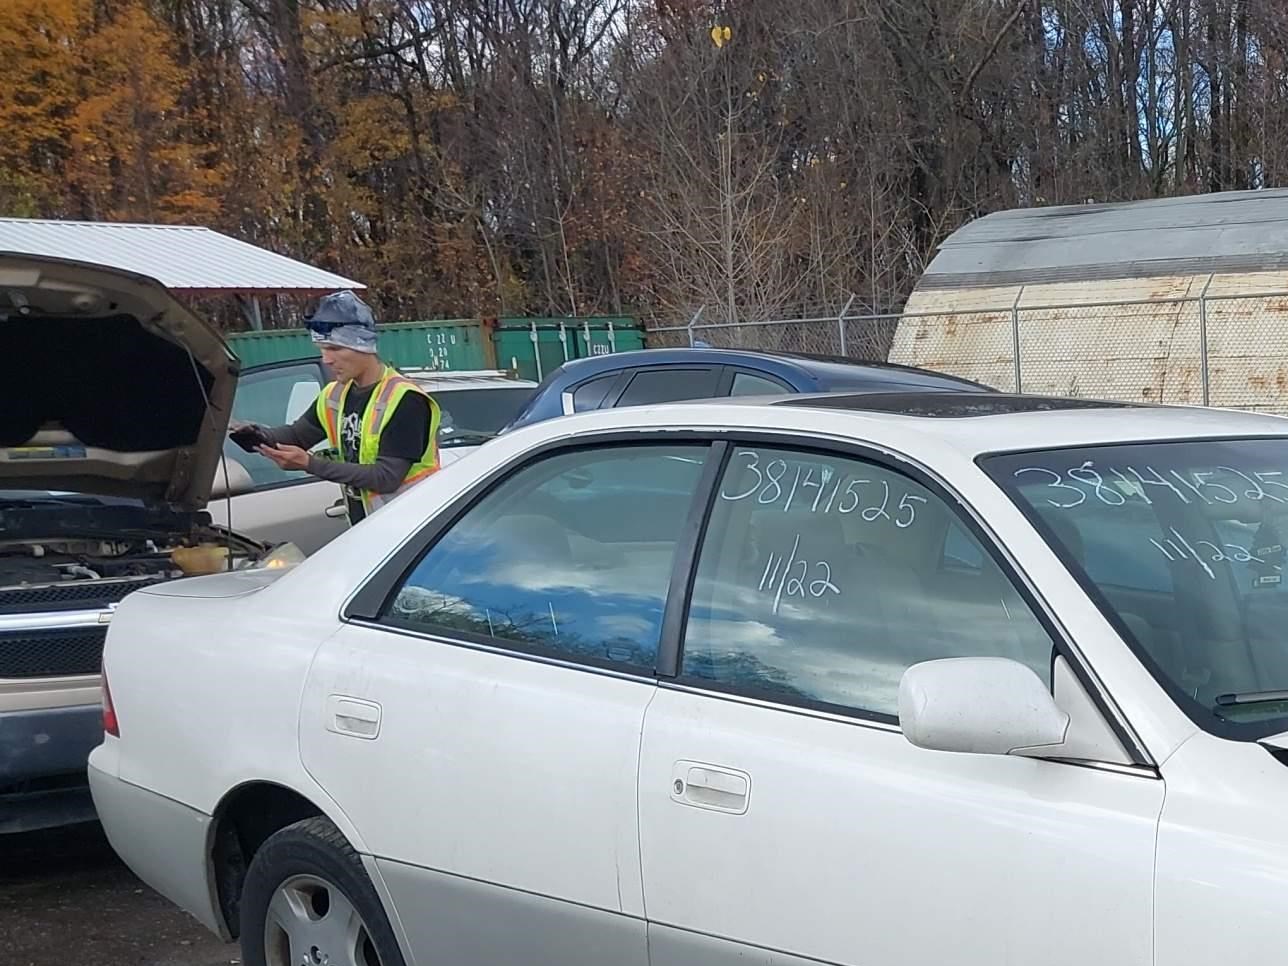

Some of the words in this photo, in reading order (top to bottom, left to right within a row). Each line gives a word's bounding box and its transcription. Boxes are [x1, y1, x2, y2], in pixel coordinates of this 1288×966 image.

[721, 451, 927, 528] 38141525
[758, 534, 840, 615] 11/22
[1148, 526, 1265, 580] 11/22
